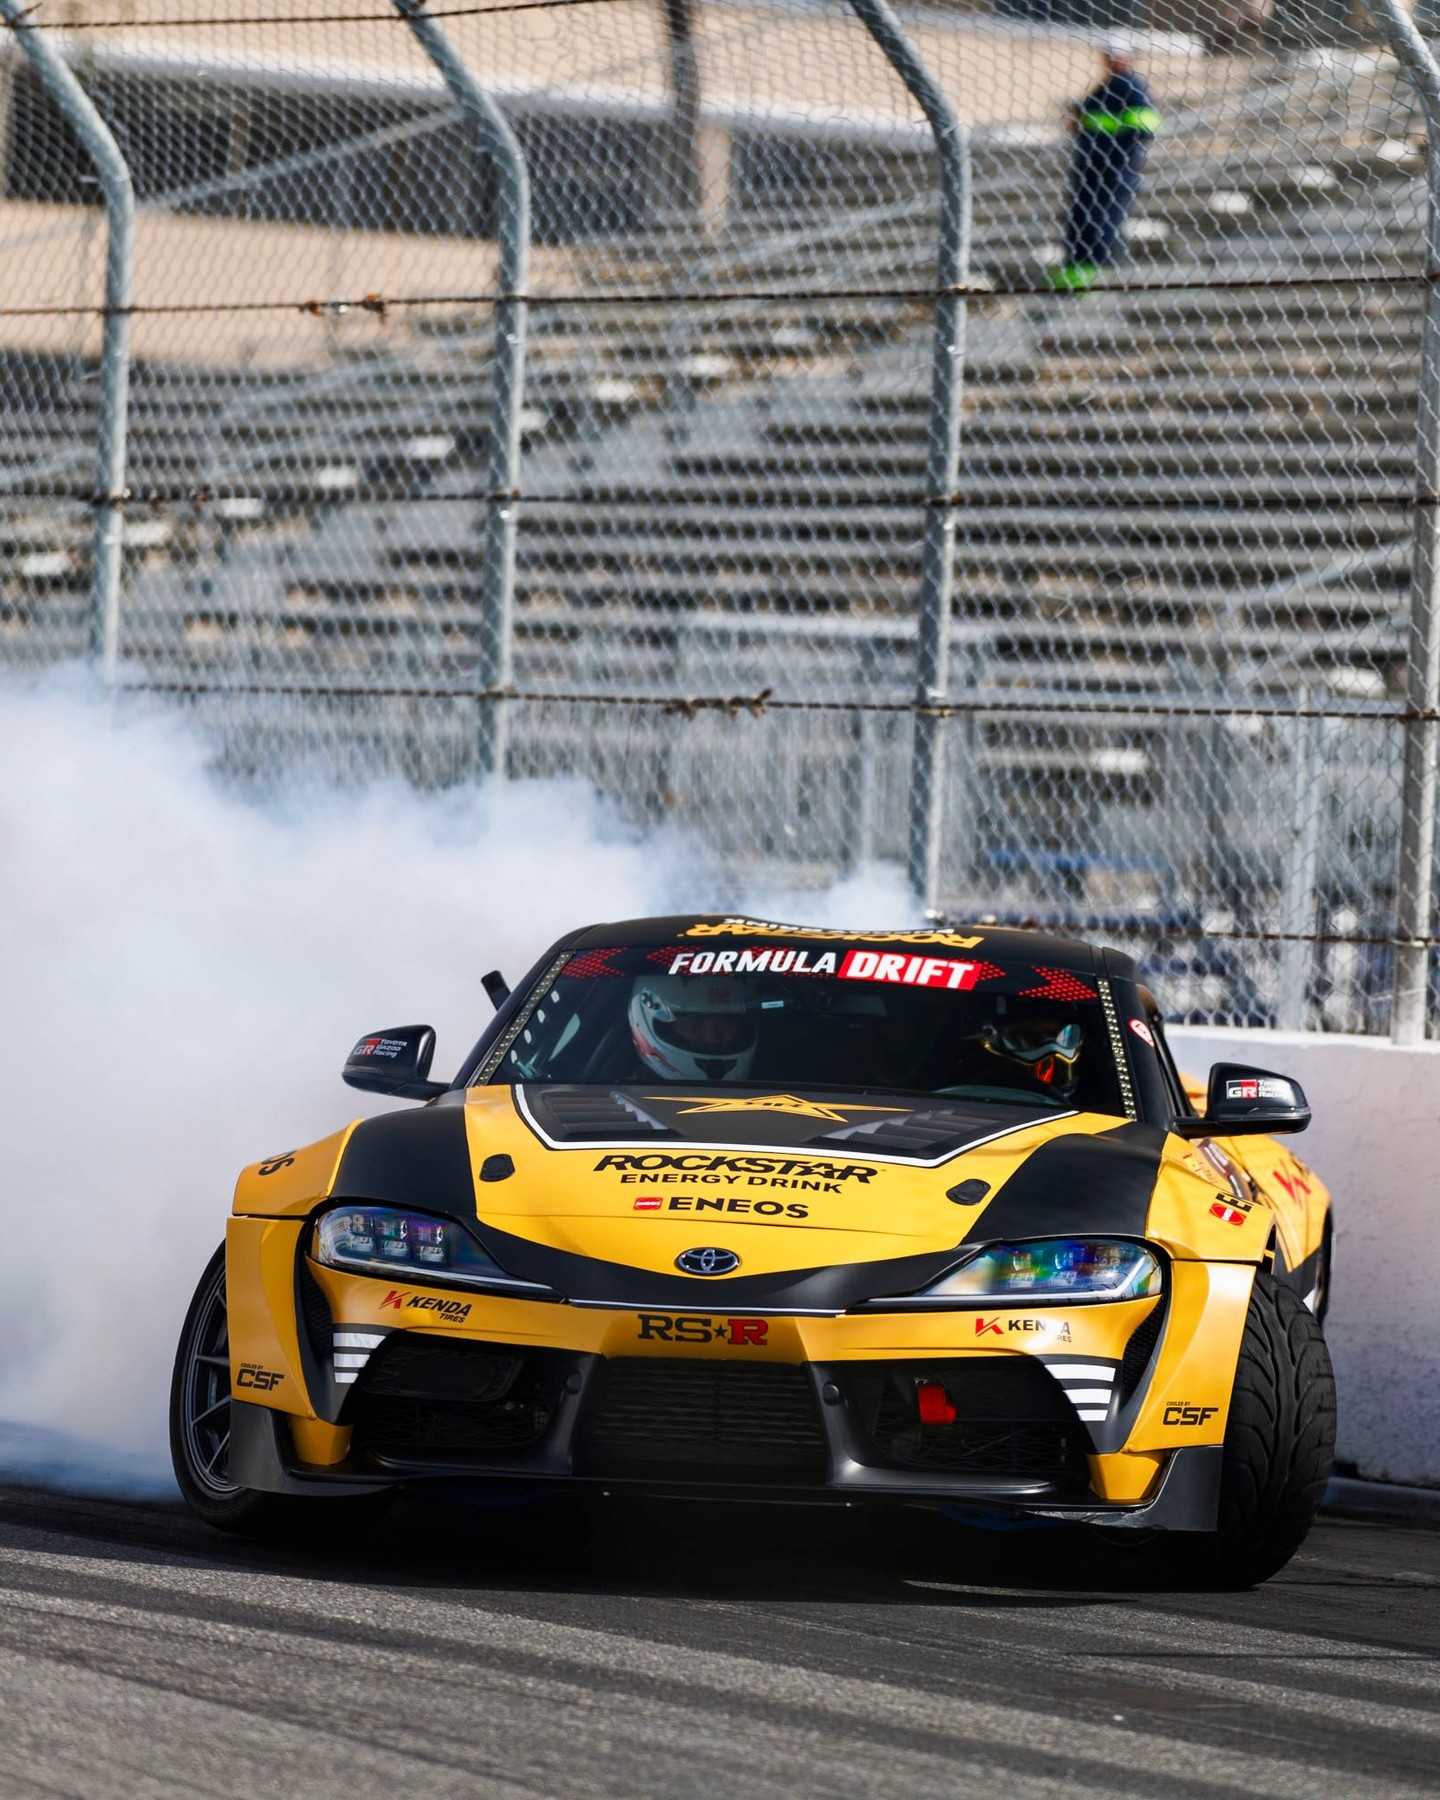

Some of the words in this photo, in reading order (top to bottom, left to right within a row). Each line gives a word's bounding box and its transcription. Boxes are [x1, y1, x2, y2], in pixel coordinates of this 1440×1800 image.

[669, 950, 837, 975] FORMULA
[846, 952, 974, 988] DRIFT
[354, 1045, 375, 1056] GR
[1228, 1086, 1257, 1098] GR
[593, 1154, 878, 1184] ROCKSTAR
[620, 1173, 742, 1185] ENERGY
[748, 1176, 843, 1194] DRINK
[668, 1196, 809, 1219] ENEOS
[406, 1296, 473, 1317] KENDA
[439, 1312, 466, 1324] TIRES
[1008, 1319, 1071, 1335] KENA
[236, 1368, 285, 1391] CSF
[1162, 1407, 1219, 1426] CSF
